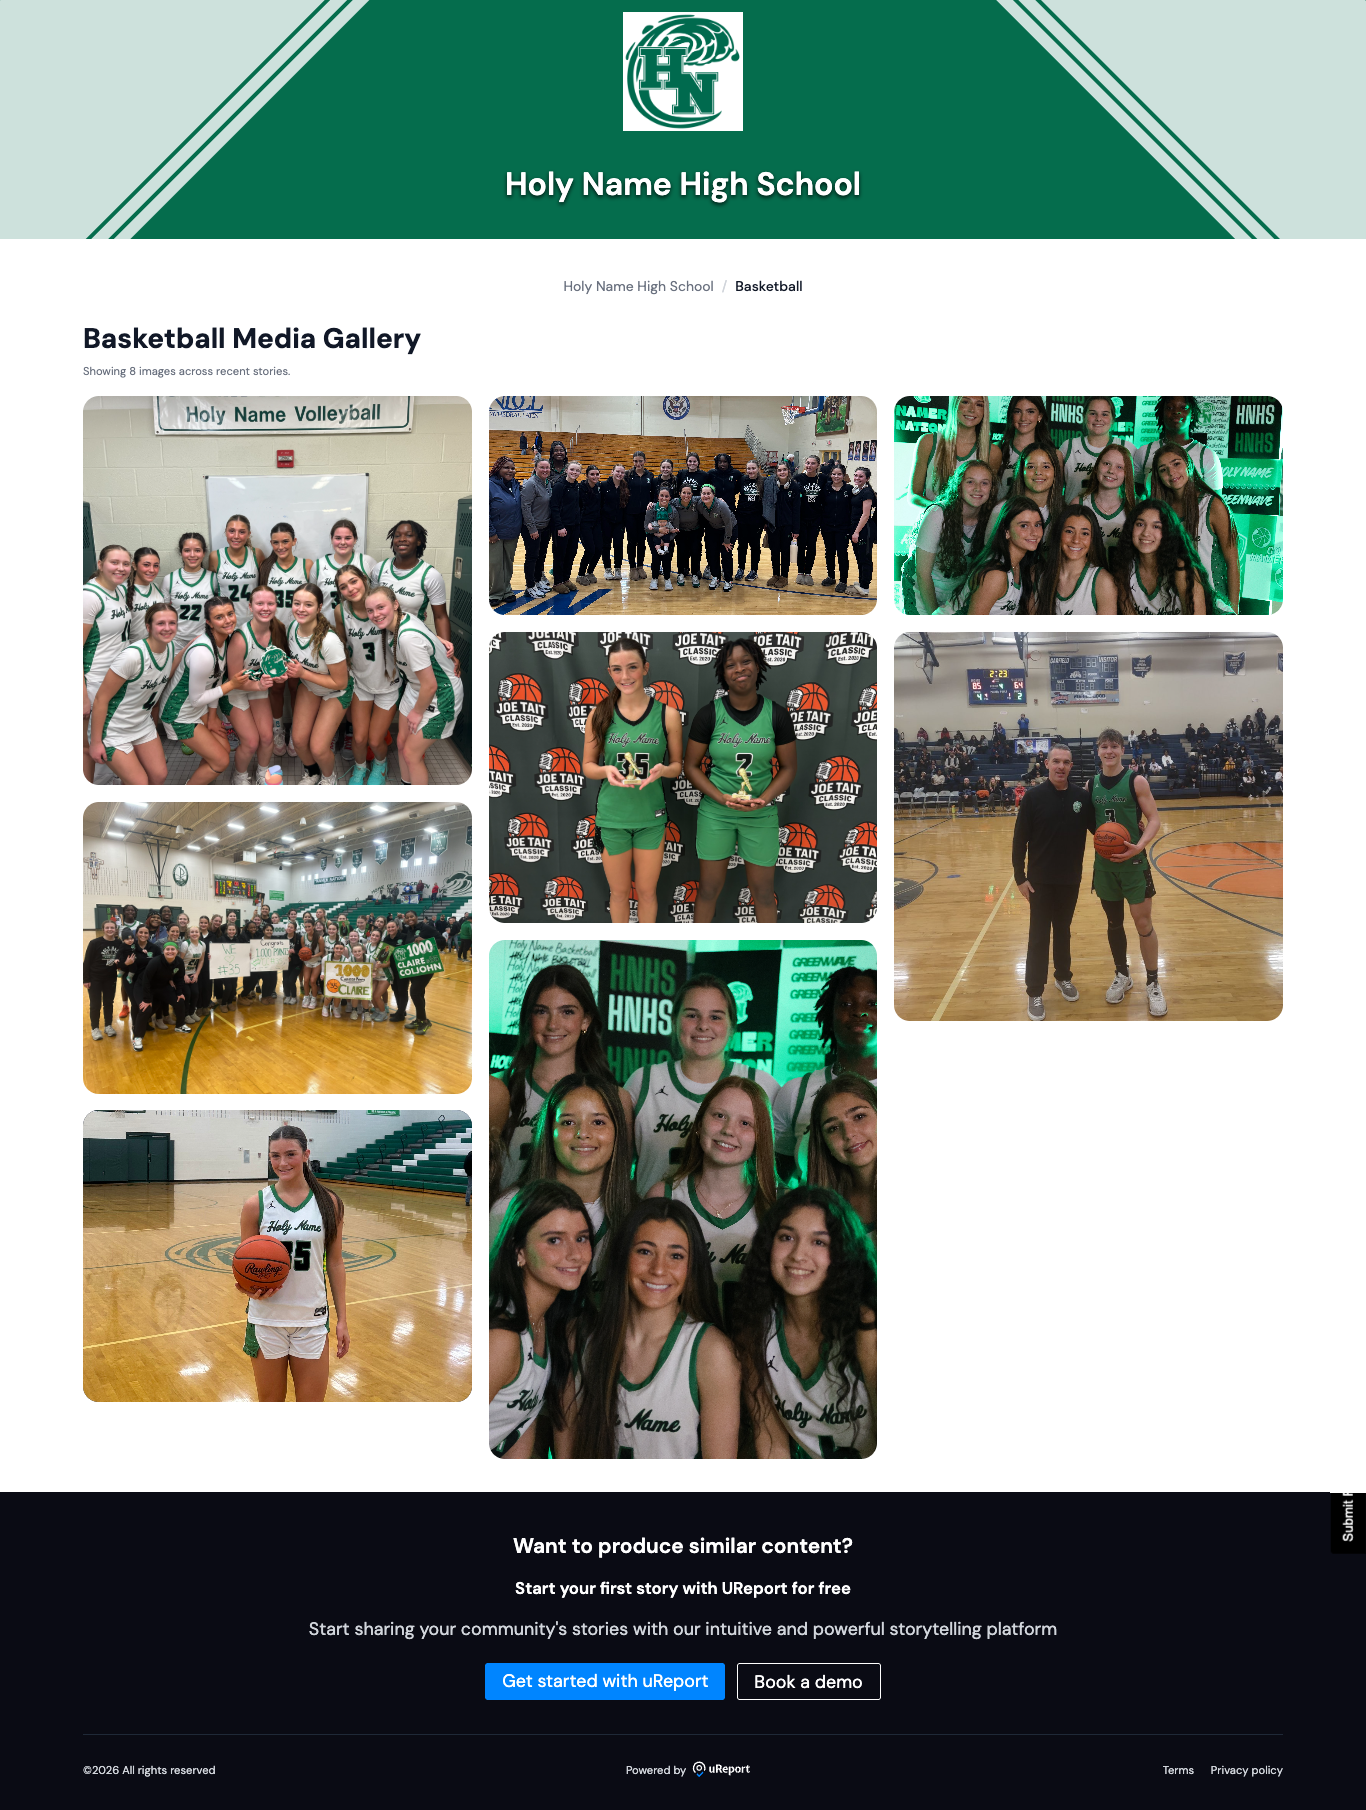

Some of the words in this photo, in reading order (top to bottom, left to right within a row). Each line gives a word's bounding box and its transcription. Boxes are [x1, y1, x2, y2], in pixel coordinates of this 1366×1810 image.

[506, 170, 574, 203] Holy
[583, 171, 672, 197] Name
[680, 170, 748, 204] High
[757, 170, 860, 197] School
[563, 280, 593, 295] Holy
[596, 280, 634, 292] Name
[637, 280, 666, 295] High
[669, 280, 714, 292] School
[735, 280, 803, 292] Basketball
[84, 326, 225, 350] Basketball
[233, 326, 316, 349] Media
[323, 326, 422, 355] Gallery
[83, 366, 127, 379] Showing
[129, 366, 136, 376] 8
[139, 366, 176, 379] images
[178, 368, 214, 376] across
[216, 367, 251, 376] recent
[252, 366, 291, 376] stories.
[186, 406, 225, 425] Holy
[234, 407, 286, 422] Name
[294, 404, 381, 424] Volleyball
[895, 405, 948, 419] NAMER
[1051, 403, 1084, 424] HNHS
[1236, 405, 1275, 425] HNHS
[1235, 433, 1274, 453] HNHS
[1222, 467, 1239, 478] OLY
[1241, 467, 1275, 479] NAME
[1222, 494, 1275, 507] REENWAVE
[228, 584, 251, 602] 24
[179, 604, 202, 622] 22
[675, 633, 697, 646] JOE
[701, 633, 726, 647] TAIT
[362, 642, 376, 662] 3
[682, 647, 718, 656] CLASSIC
[989, 670, 1008, 678] 2:23
[972, 682, 982, 690] 85
[1014, 681, 1024, 689] 64
[496, 702, 518, 714] JOE
[520, 702, 546, 716] TAIT
[505, 715, 539, 723] CLASSIC
[735, 752, 753, 777] 2
[536, 773, 559, 785] JOE
[560, 773, 585, 786] TAIT
[544, 785, 578, 793] CLASSIC
[811, 782, 834, 795] JOE
[836, 782, 862, 795] TAIT
[818, 795, 853, 803] CLASSIC
[506, 837, 525, 848] JOE
[528, 837, 552, 849] TAIT
[542, 898, 562, 908] JOE
[563, 898, 586, 909] TAIT
[222, 943, 236, 955] WE
[407, 940, 433, 957] 1000
[509, 940, 528, 952] Holy
[529, 940, 553, 954] Name
[397, 957, 426, 969] CLAIRE
[792, 956, 857, 968] GREENWAVE
[217, 964, 241, 976] #35
[334, 964, 370, 978] 1000
[399, 963, 443, 977] COLJOHN
[609, 953, 677, 996] HNHS
[338, 984, 370, 996] CLAIRE
[607, 994, 674, 1036] HNHS
[653, 1113, 694, 1140] Holy
[267, 1219, 293, 1236] Holy
[294, 1219, 322, 1233] Name
[774, 1395, 812, 1429] Holy
[816, 1400, 868, 1424] Name
[624, 1407, 681, 1433] Name
[1342, 1499, 1354, 1542] Submit
[512, 1537, 567, 1555] Want
[571, 1538, 593, 1555] to
[598, 1536, 684, 1559] produce
[688, 1536, 757, 1555] similar
[761, 1536, 854, 1555] content?
[514, 1581, 556, 1596] Start
[559, 1584, 597, 1599] your
[599, 1580, 633, 1595] first
[636, 1582, 679, 1599] story
[682, 1580, 718, 1595] with
[721, 1581, 788, 1599] UReport
[791, 1580, 815, 1595] for
[817, 1580, 852, 1595] free
[308, 1621, 350, 1636] Start
[354, 1621, 416, 1640] sharing
[419, 1624, 457, 1640] your
[460, 1620, 568, 1640] community's
[571, 1621, 629, 1636] stories
[632, 1621, 669, 1636] with
[672, 1624, 702, 1636] our
[705, 1621, 773, 1636] intuitive
[776, 1621, 808, 1636] and
[813, 1621, 885, 1640] powerful
[889, 1621, 983, 1640] storytelling
[986, 1621, 1058, 1640] platform
[502, 1673, 533, 1688] Get
[537, 1673, 598, 1688] started
[602, 1673, 638, 1688] with
[642, 1673, 709, 1692] uReport
[754, 1674, 796, 1690] Book
[800, 1677, 810, 1690] a
[814, 1674, 863, 1690] demo
[82, 1765, 120, 1775] ©2026
[121, 1764, 135, 1775] All
[137, 1765, 168, 1778] rights
[170, 1765, 216, 1775] reserved
[625, 1765, 671, 1775] Powered
[673, 1765, 687, 1778] by
[708, 1763, 751, 1777] uReport
[1162, 1765, 1195, 1775] Terms
[1210, 1765, 1249, 1778] Privacy
[1251, 1764, 1284, 1778] policy
